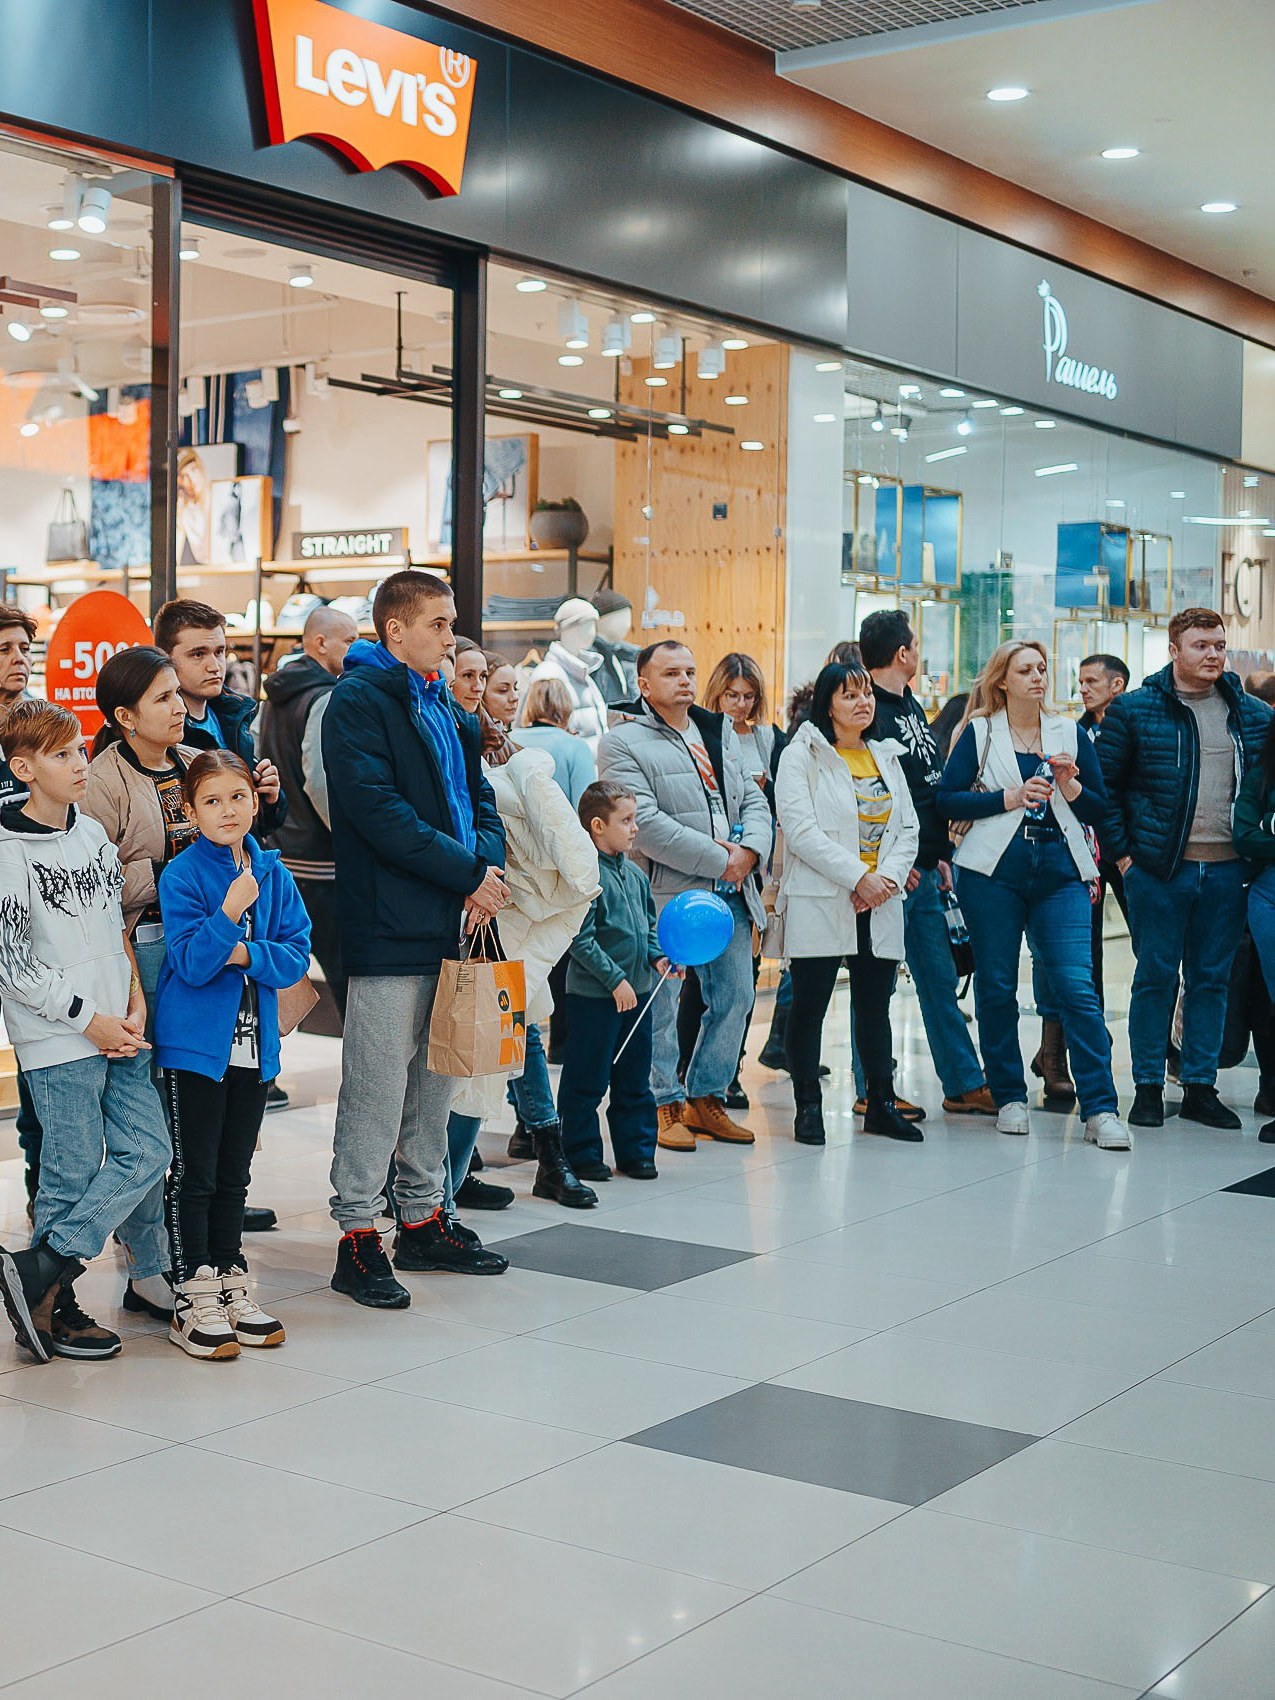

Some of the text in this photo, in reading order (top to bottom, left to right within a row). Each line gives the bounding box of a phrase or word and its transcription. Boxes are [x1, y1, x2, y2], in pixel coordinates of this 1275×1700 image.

[301, 532, 393, 557] STRAIGHT
[55, 686, 96, 701] НА ВТО
